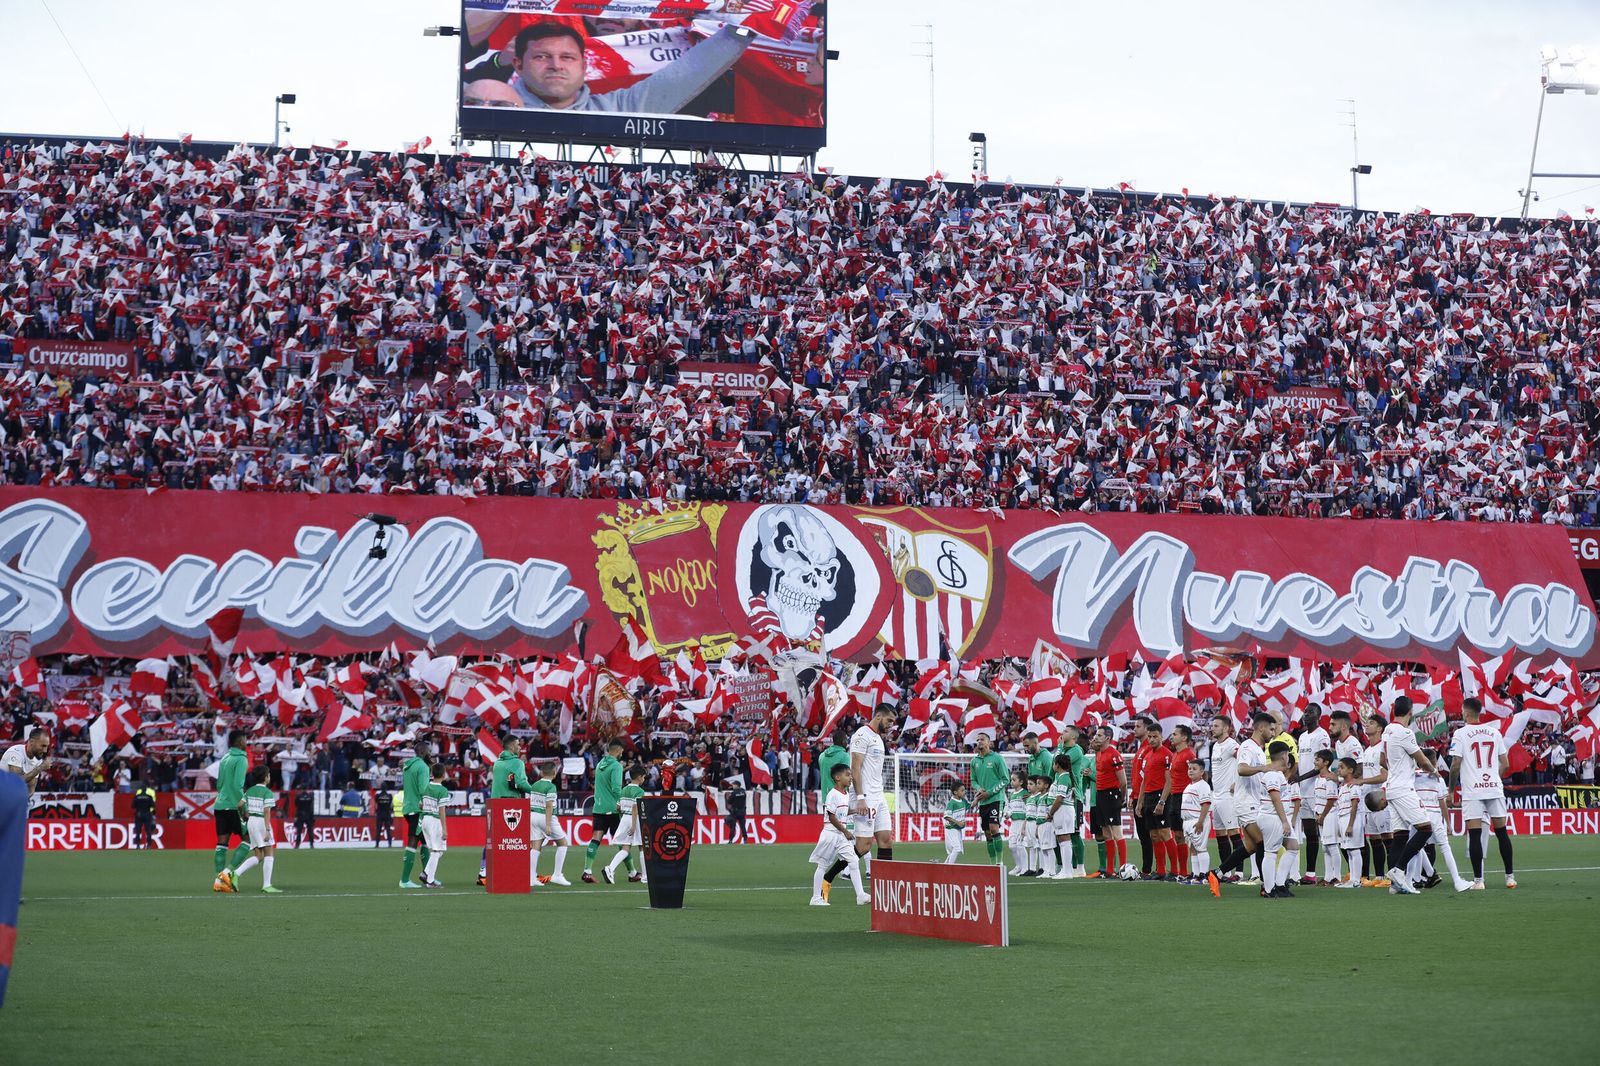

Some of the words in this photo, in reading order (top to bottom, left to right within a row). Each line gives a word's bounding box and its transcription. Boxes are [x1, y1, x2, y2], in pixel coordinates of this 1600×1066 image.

[623, 31, 673, 47] PEÑA
[650, 46, 690, 62] GIR
[624, 118, 667, 136] AIRIS
[29, 346, 128, 369] Cruzcampo
[0, 498, 580, 640] Sevilla
[1007, 522, 1596, 656] Nuestra
[1470, 741, 1495, 769] 17
[1473, 781, 1499, 789] ANDEX
[867, 807, 877, 820] 12
[1523, 812, 1553, 835] TE
[313, 827, 371, 842] SEVILLA
[874, 878, 914, 915] NUNCA
[915, 881, 930, 917] TE
[932, 882, 980, 922] RINDAS
